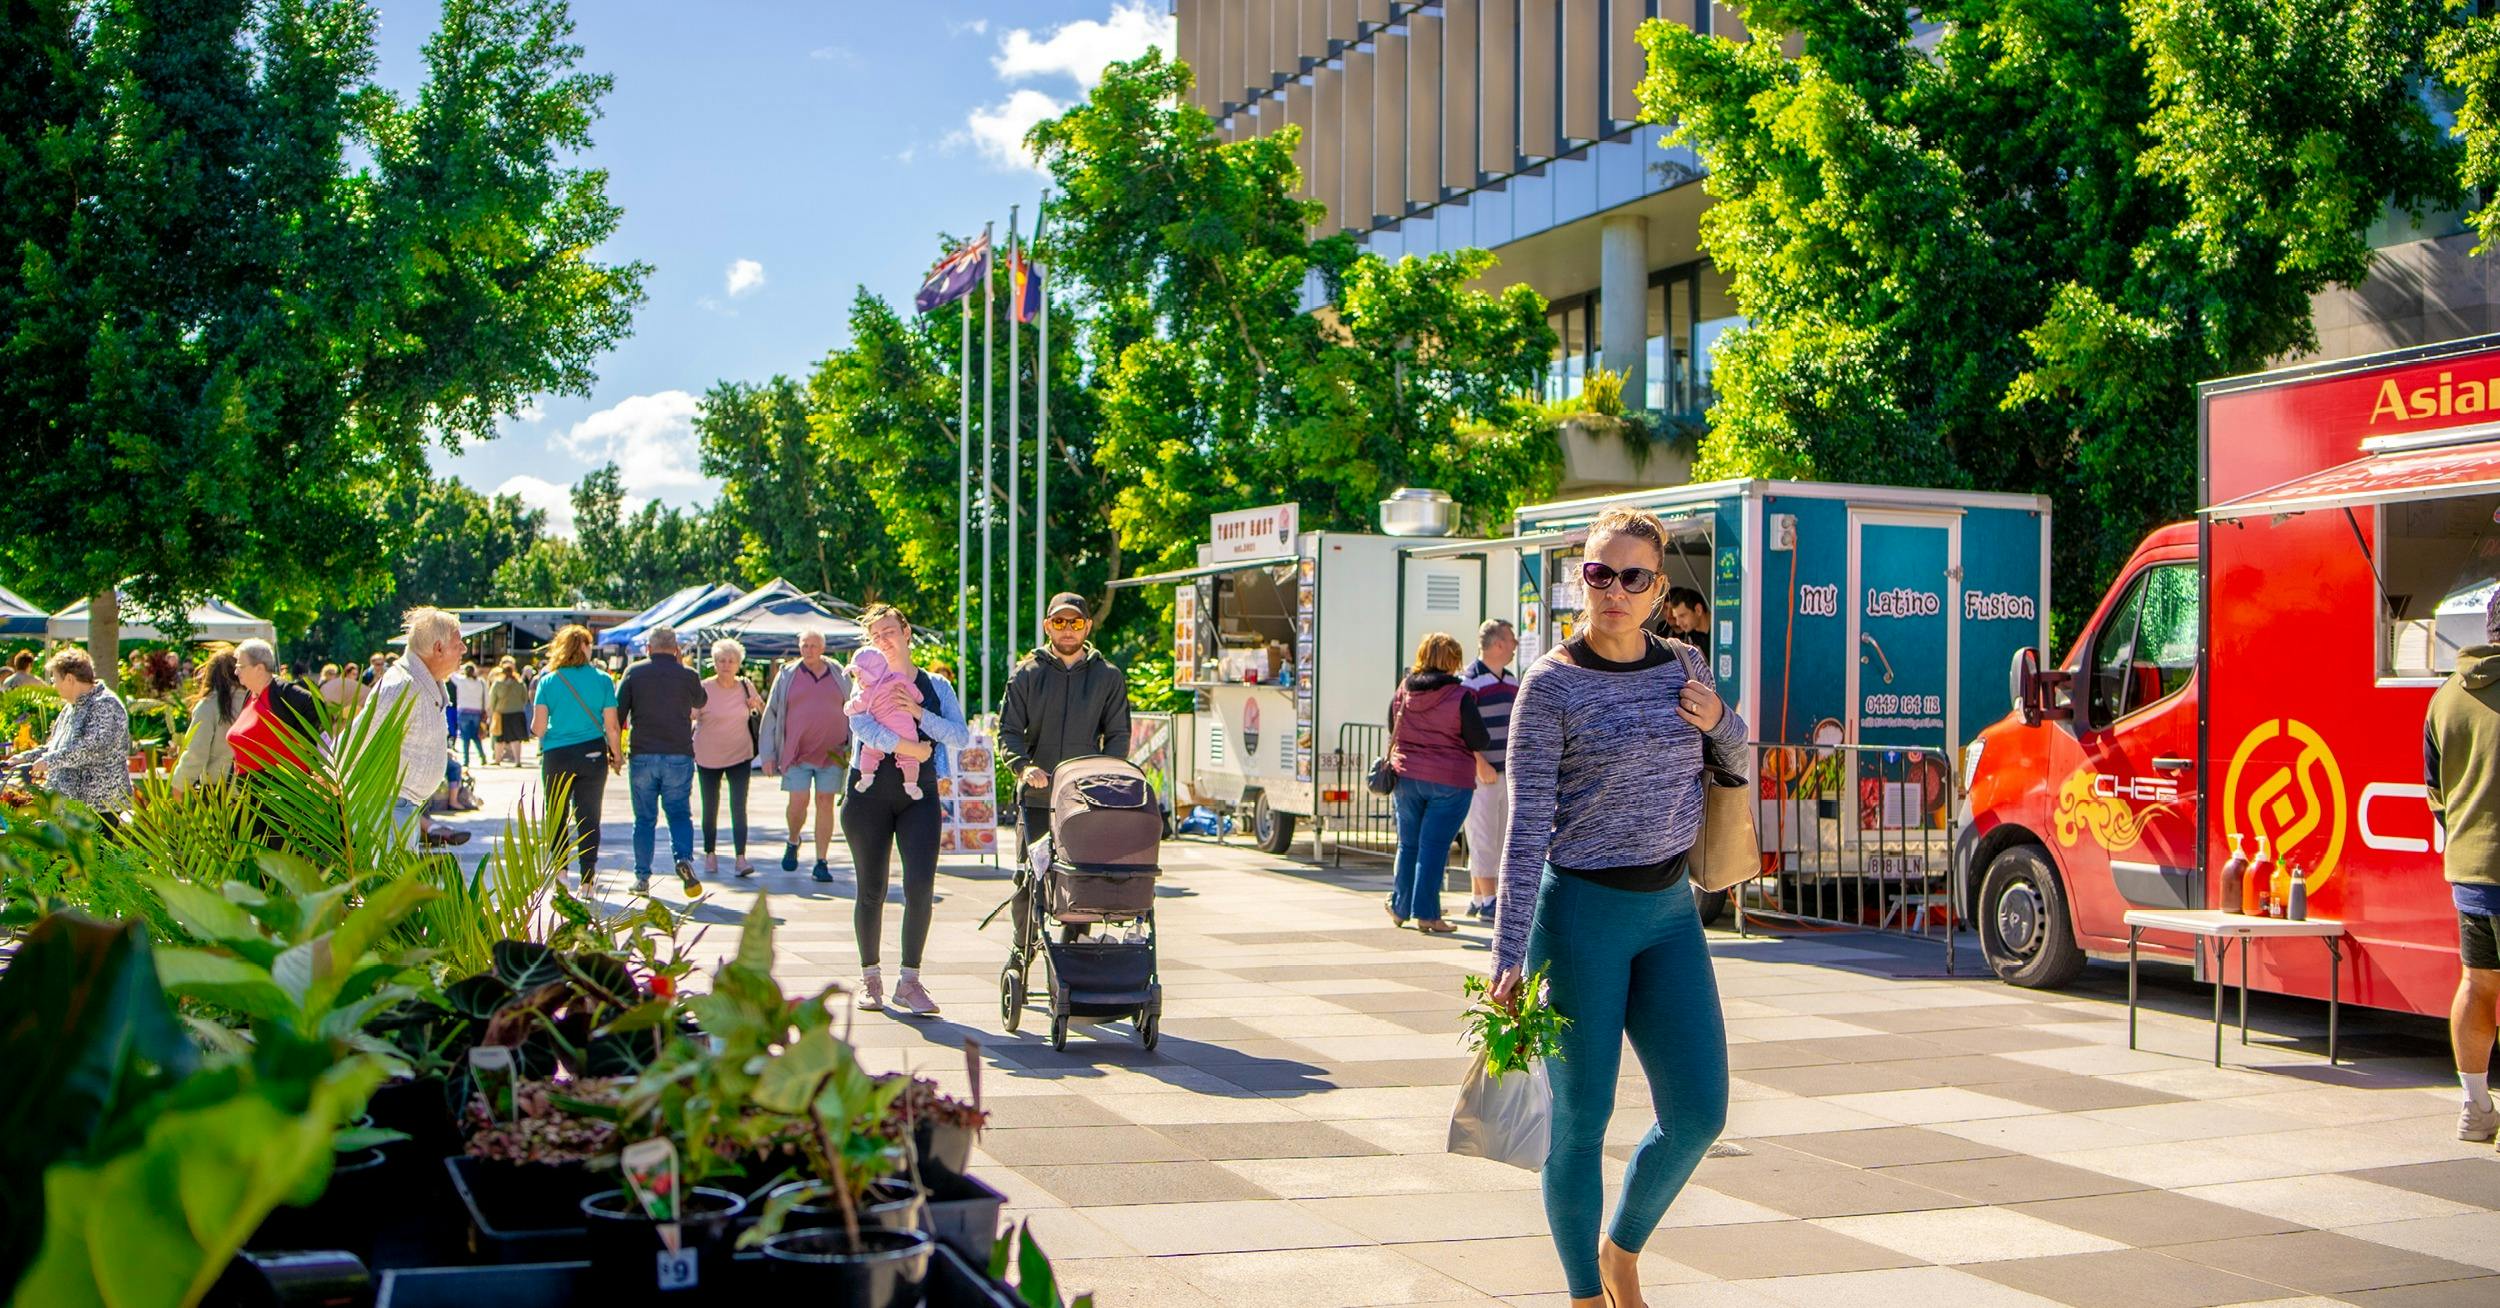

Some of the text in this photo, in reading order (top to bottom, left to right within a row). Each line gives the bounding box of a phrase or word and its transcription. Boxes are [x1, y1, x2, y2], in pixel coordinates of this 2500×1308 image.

[1868, 588, 1939, 617] Latino
[1965, 591, 2034, 619] Fusion
[1866, 695, 1897, 713] 0449
